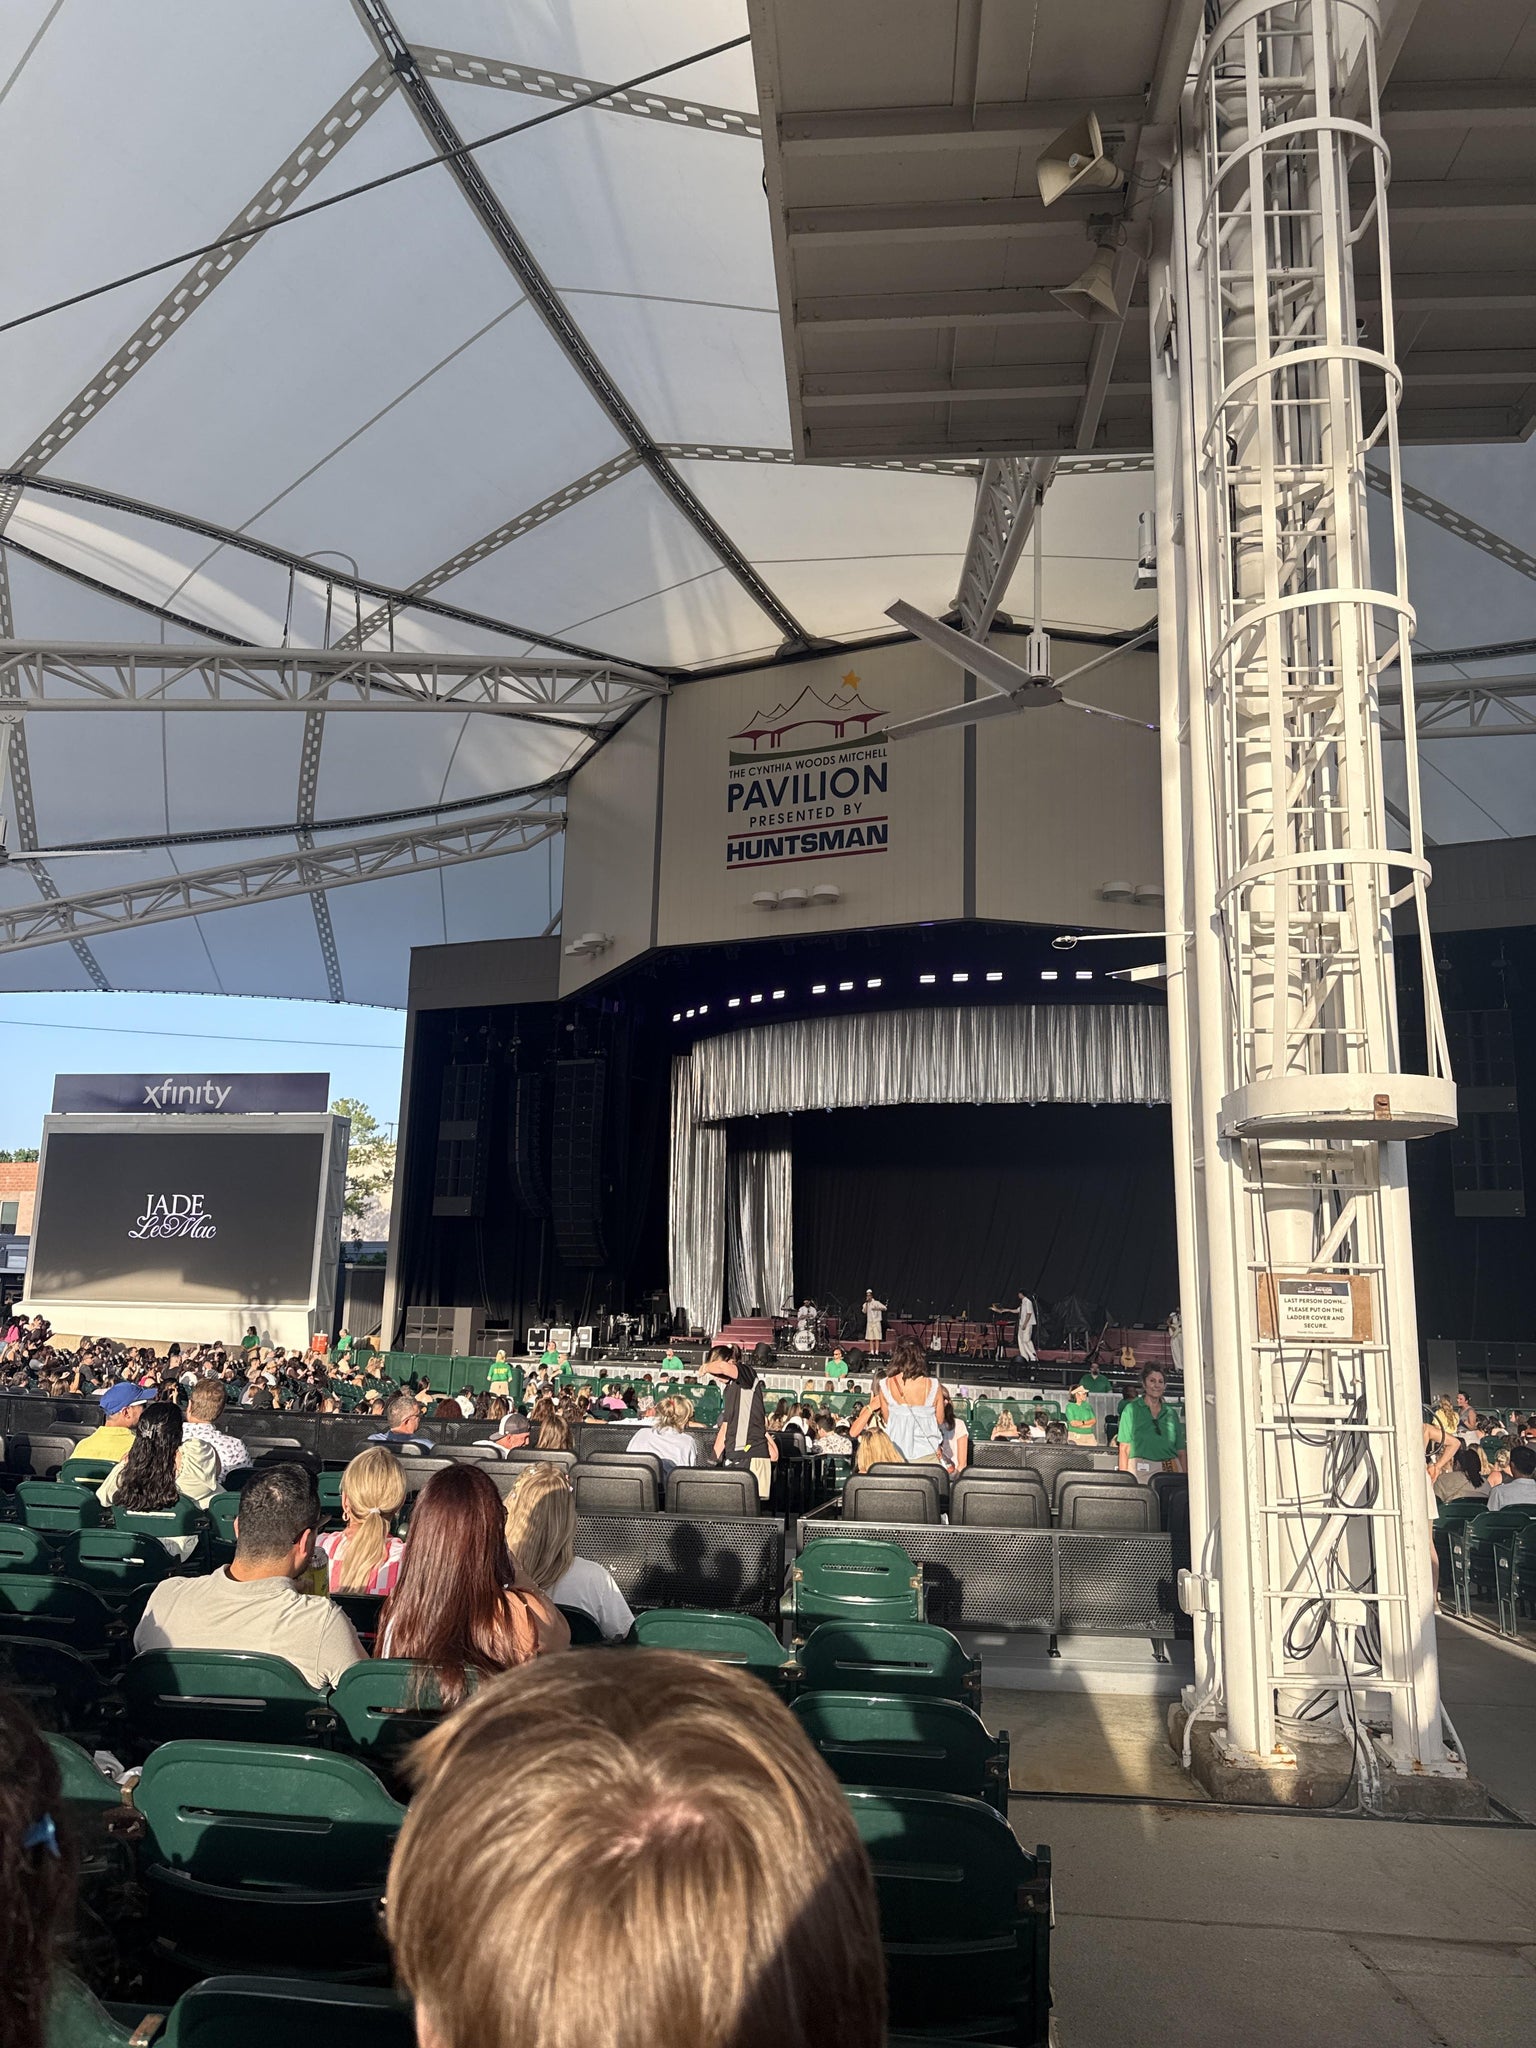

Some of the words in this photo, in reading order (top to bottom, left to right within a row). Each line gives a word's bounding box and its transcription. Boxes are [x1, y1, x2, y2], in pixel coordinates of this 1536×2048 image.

[729, 769, 746, 779] THE
[749, 762, 792, 776] CYNTHIA
[795, 755, 836, 769] WOODS
[838, 748, 888, 764] MITCHELL
[727, 762, 888, 812] PAVILION
[749, 806, 835, 828] PRESENTED
[843, 802, 863, 816] BY
[726, 824, 888, 862] HUNTSMAN
[142, 1078, 233, 1109] xfinity
[143, 1194, 205, 1219] JADE
